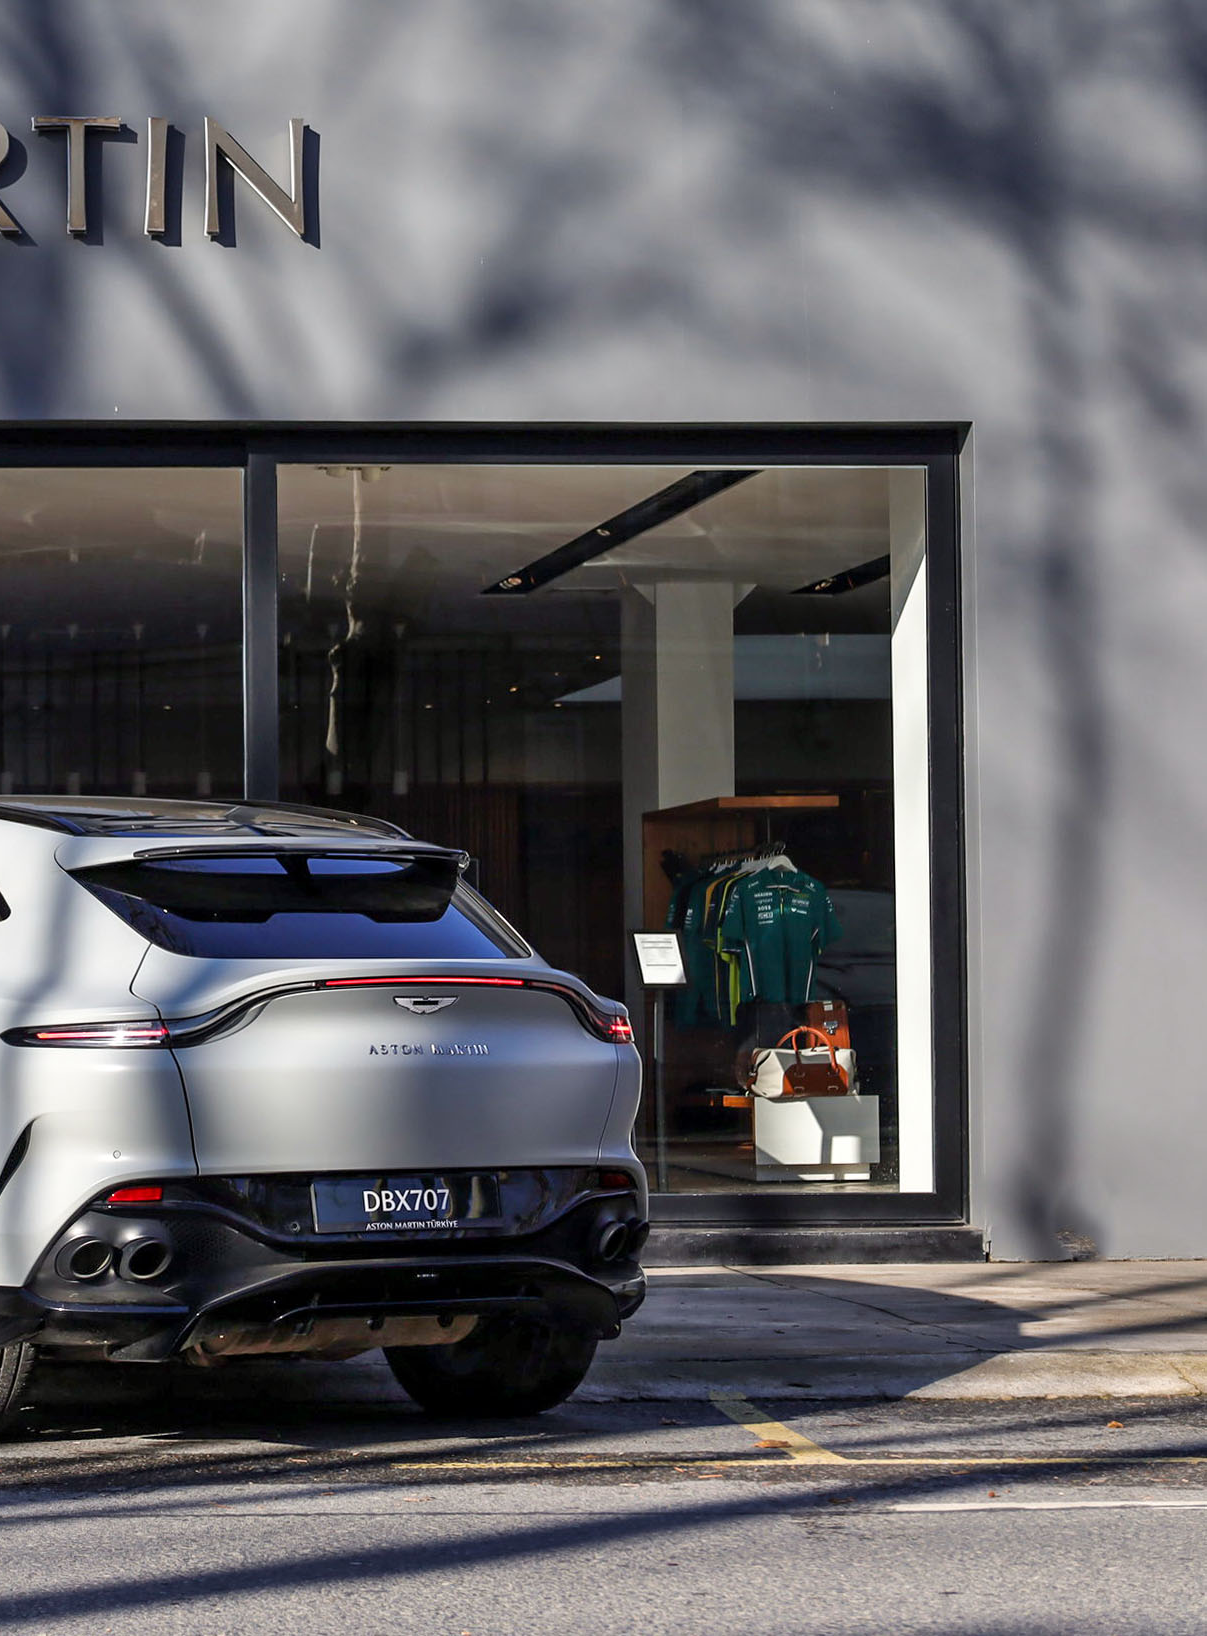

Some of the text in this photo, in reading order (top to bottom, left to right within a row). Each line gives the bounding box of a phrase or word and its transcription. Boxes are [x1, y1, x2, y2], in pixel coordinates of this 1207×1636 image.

[369, 1044, 490, 1055] ASTON MARTIN
[363, 1189, 450, 1212] DBX707
[365, 1219, 459, 1231] ASTON MARTIN TÜRKİYE
